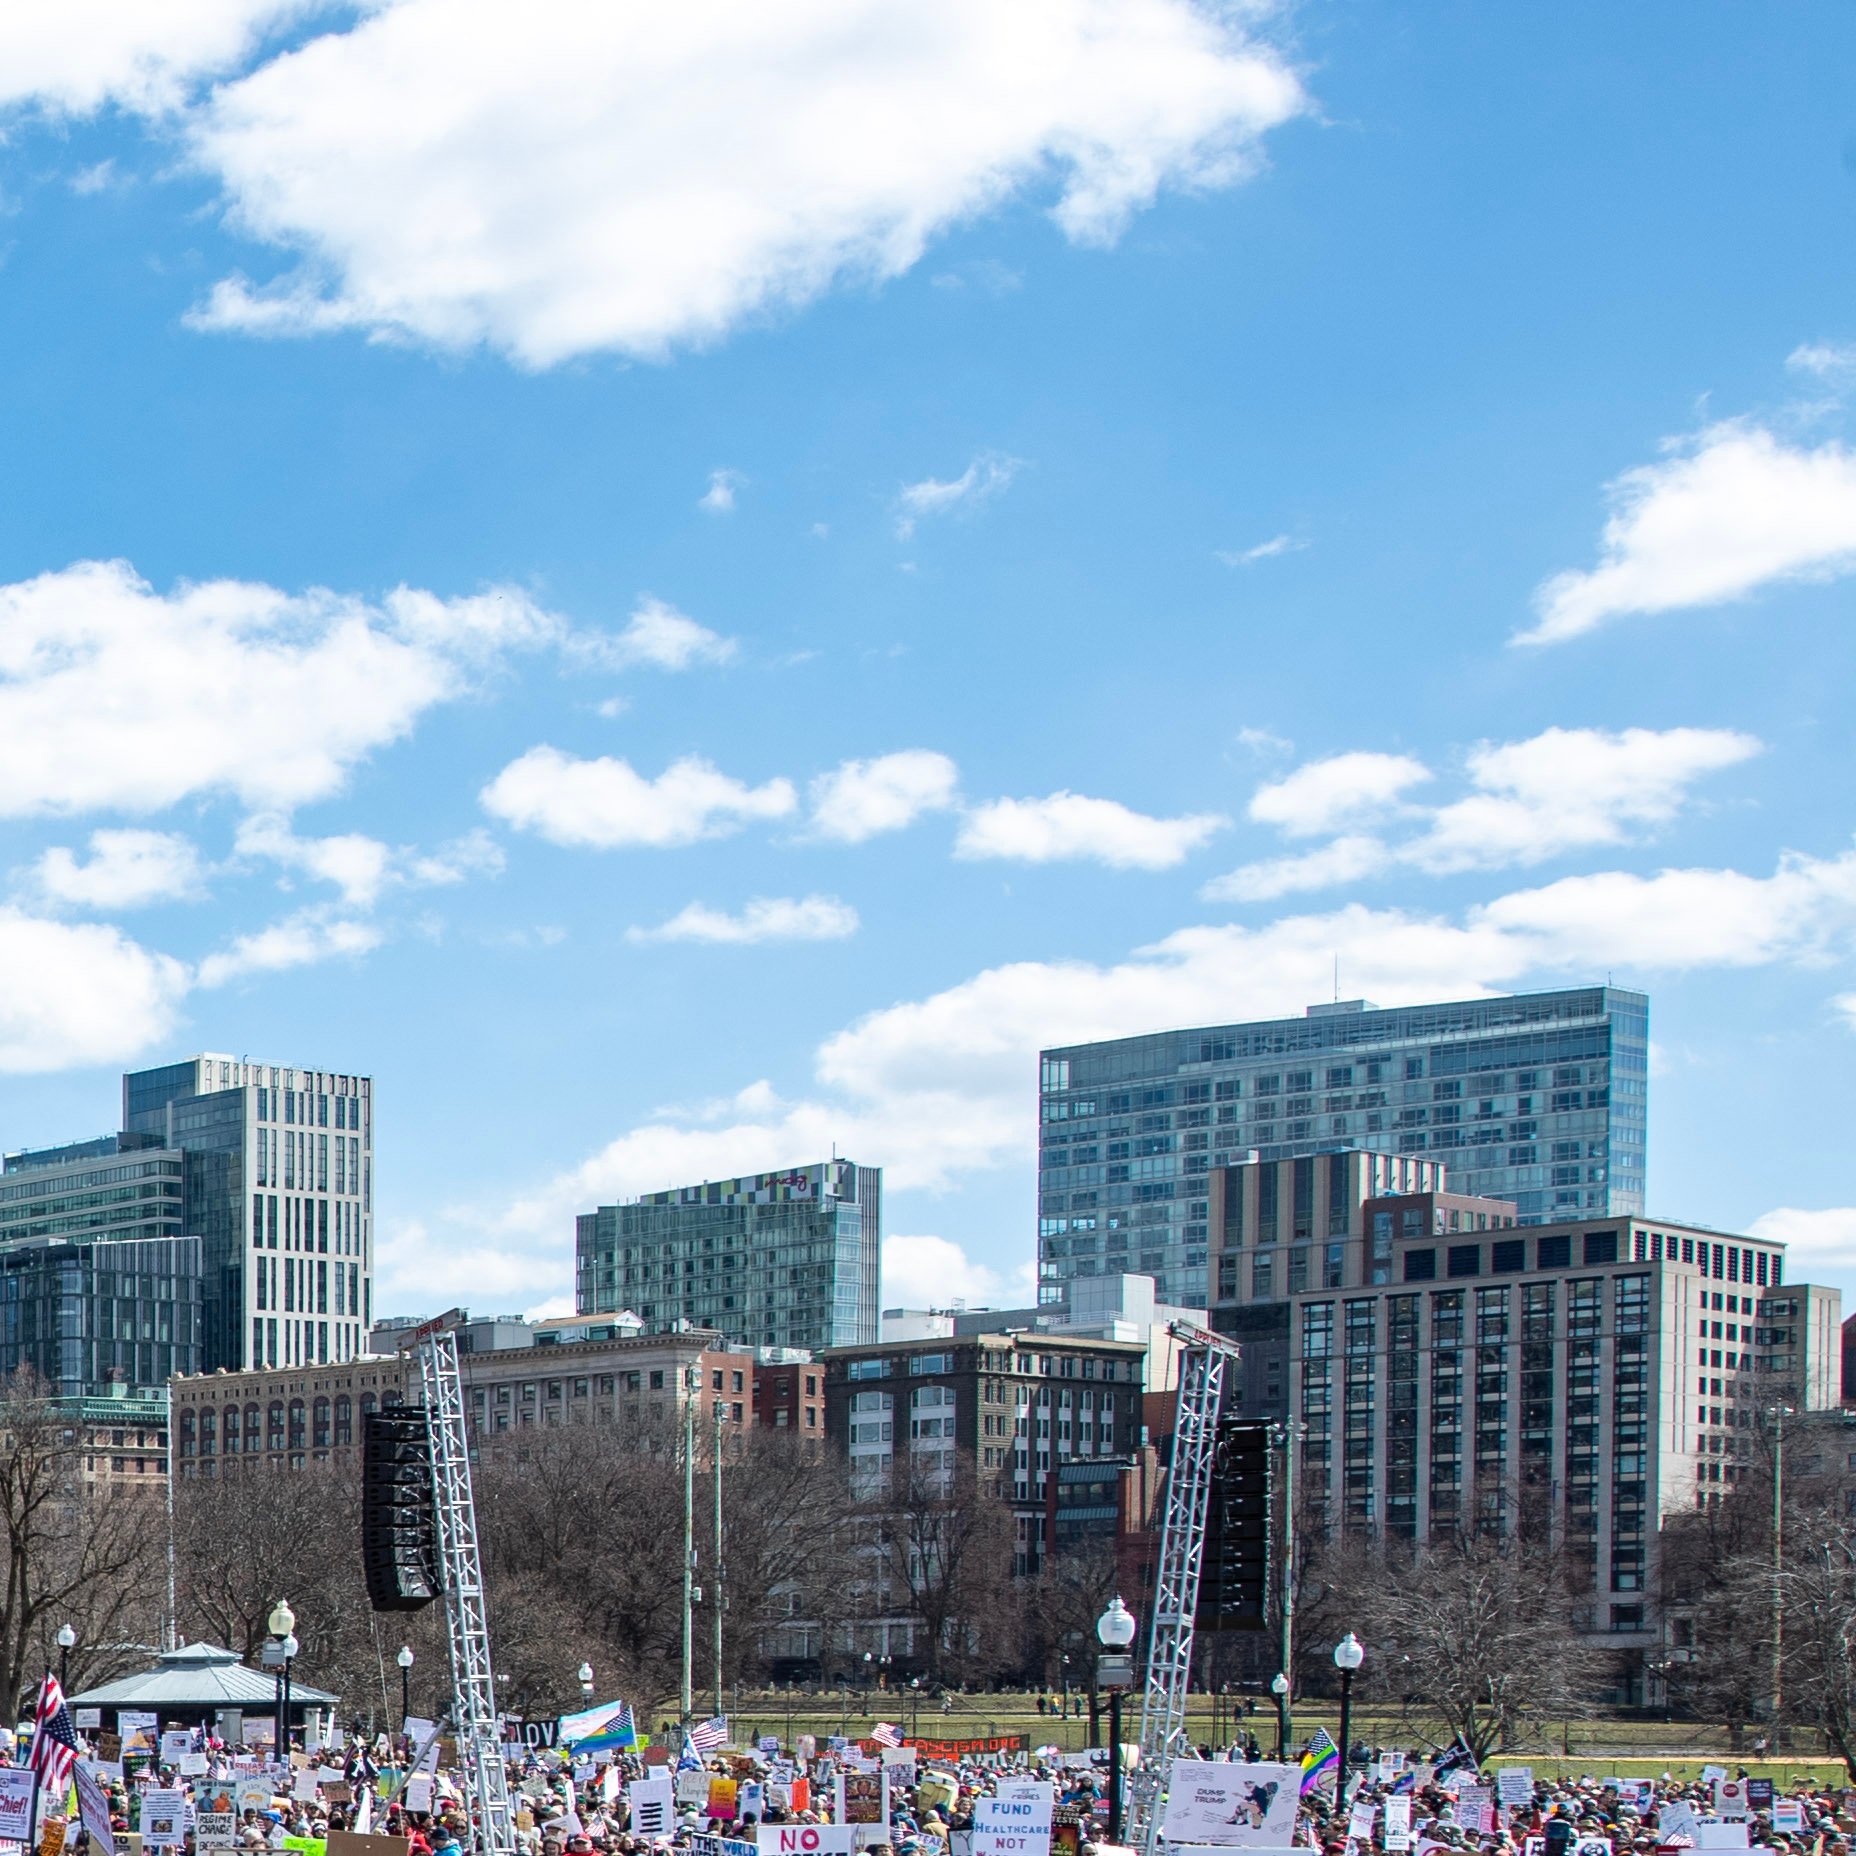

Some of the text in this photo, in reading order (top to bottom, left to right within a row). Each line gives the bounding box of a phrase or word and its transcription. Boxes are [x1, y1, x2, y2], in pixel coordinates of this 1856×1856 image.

[992, 1803, 1032, 1814] FUND
[695, 1837, 718, 1852] THE
[780, 1829, 819, 1851] NO
